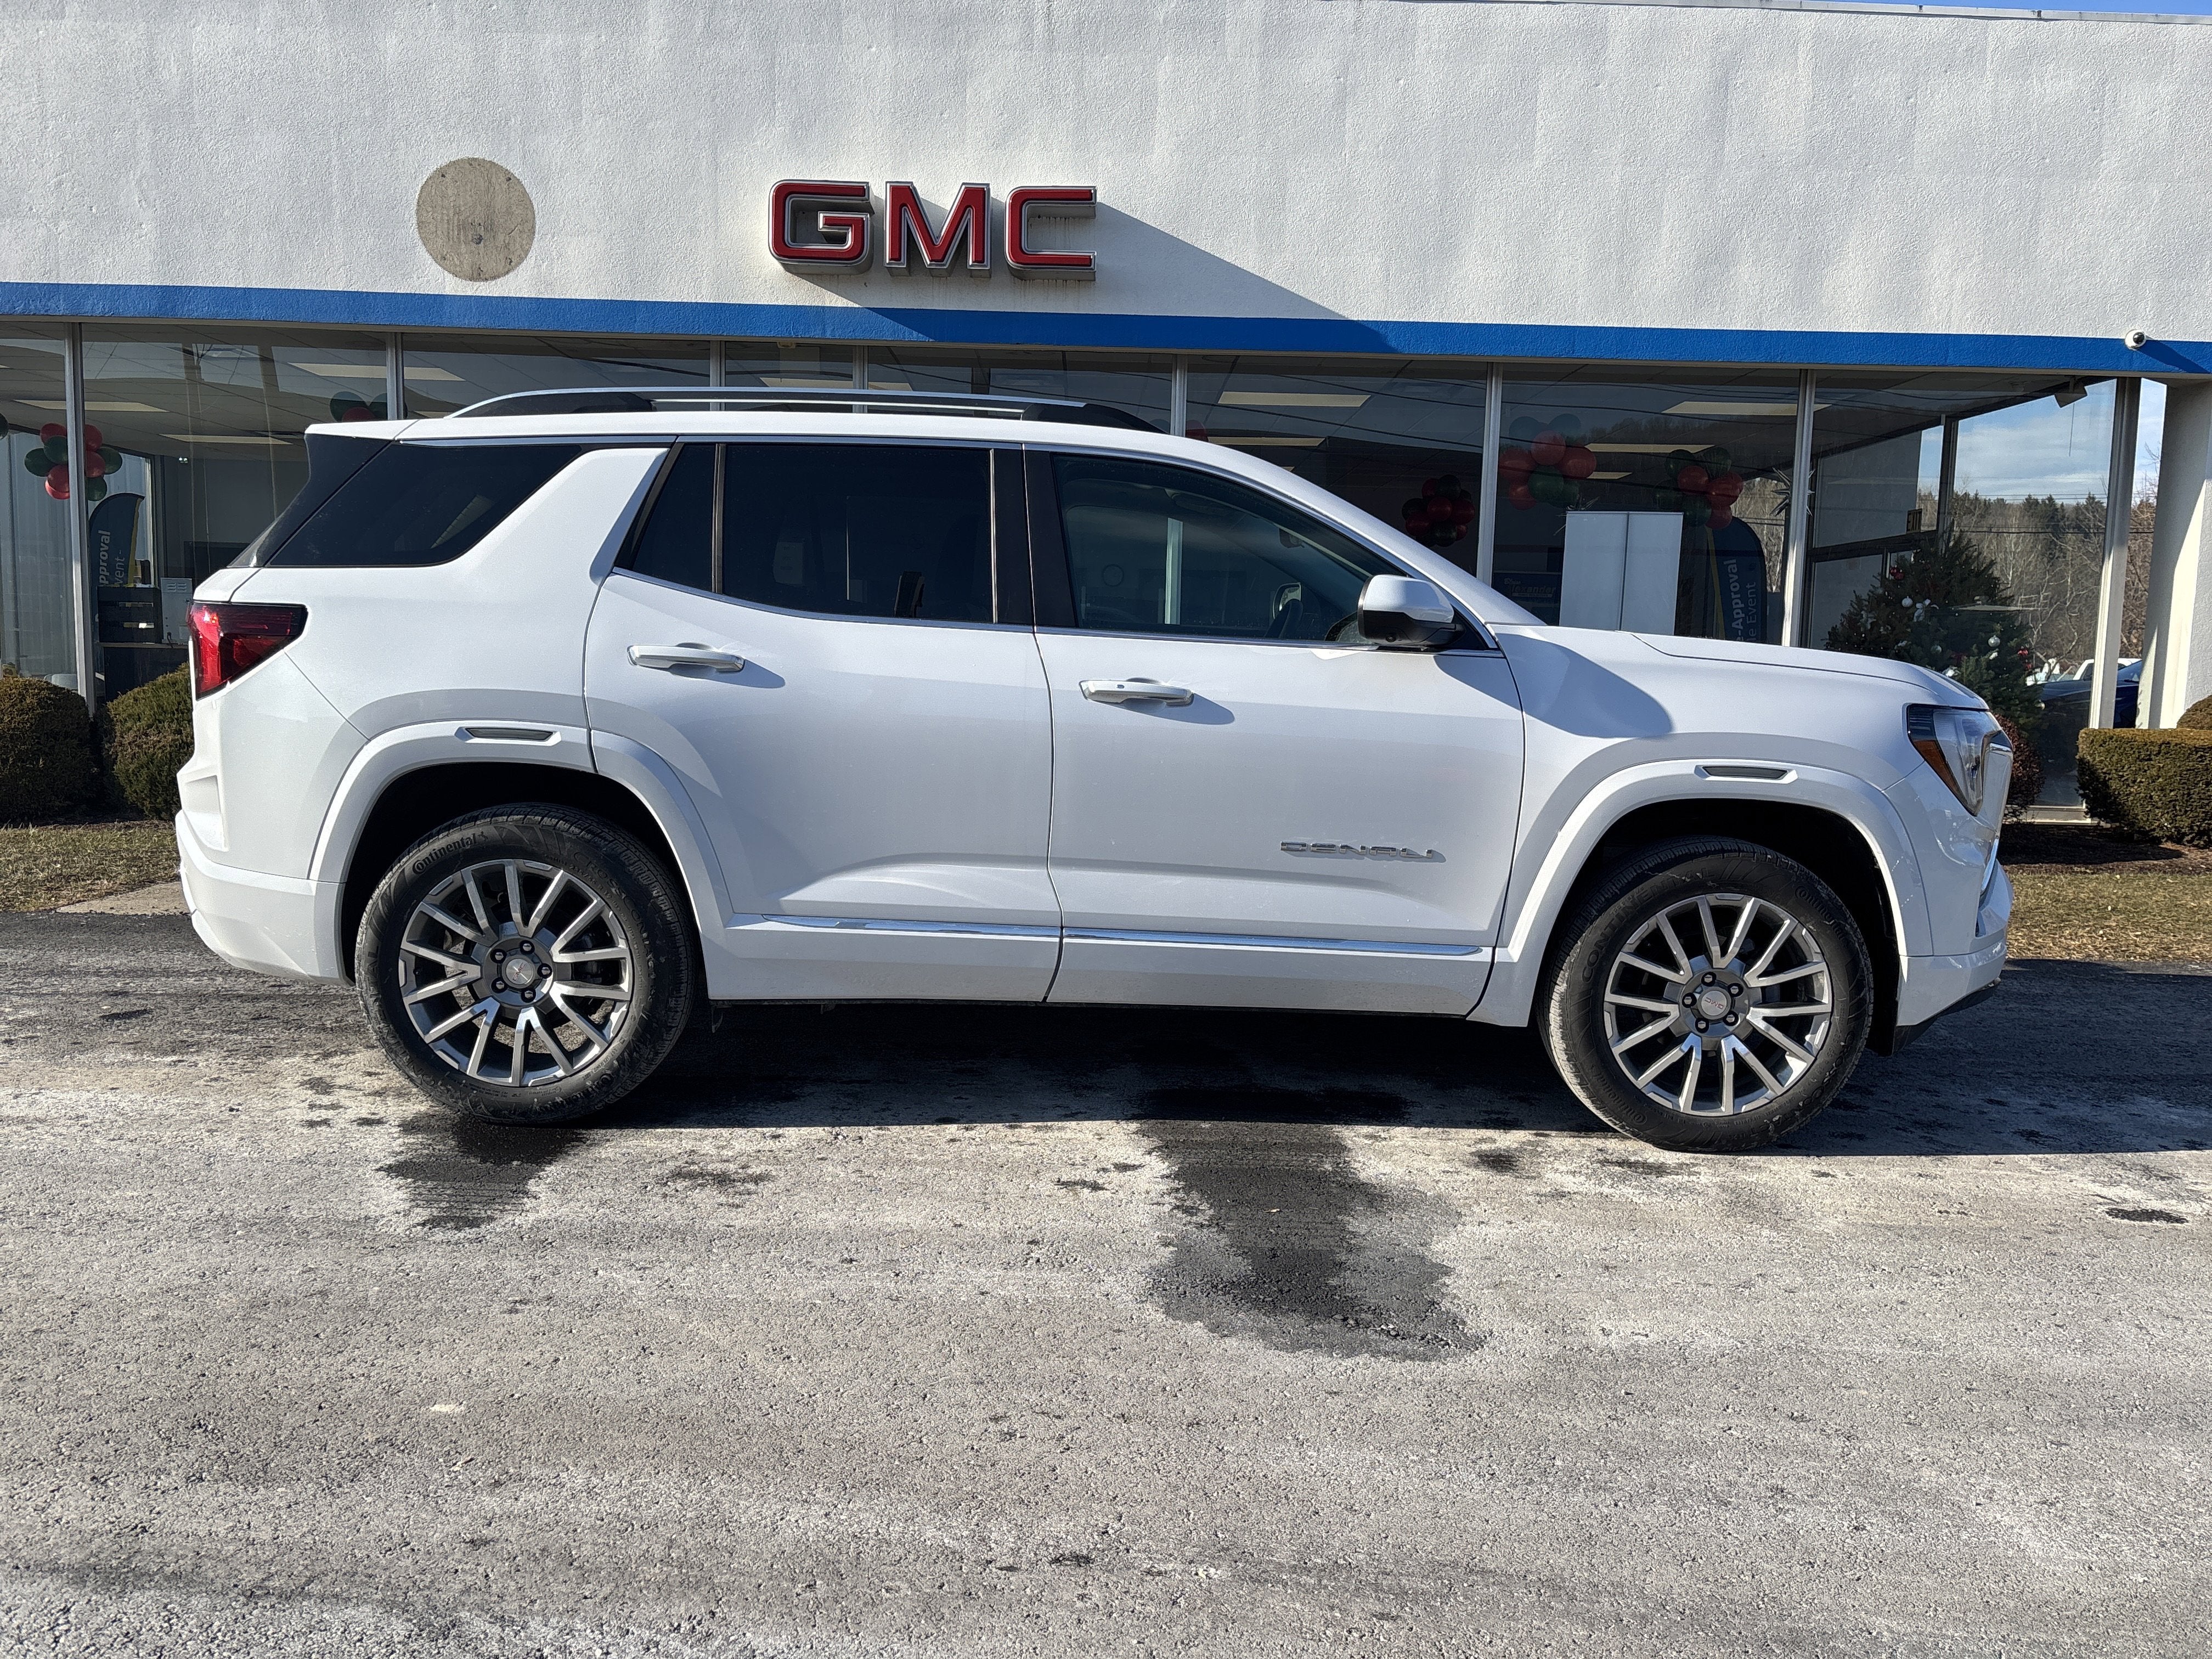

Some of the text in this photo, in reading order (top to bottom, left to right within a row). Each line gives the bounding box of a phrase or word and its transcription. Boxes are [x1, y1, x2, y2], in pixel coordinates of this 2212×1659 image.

[768, 179, 1097, 275] GMC
[1907, 511, 1922, 531] EXIT
[98, 530, 111, 586] pproval
[114, 557, 125, 585] vent
[1746, 582, 1757, 624] Event
[412, 833, 477, 875] Continental
[512, 962, 526, 981] GMC
[1704, 997, 1724, 1009] GMC
